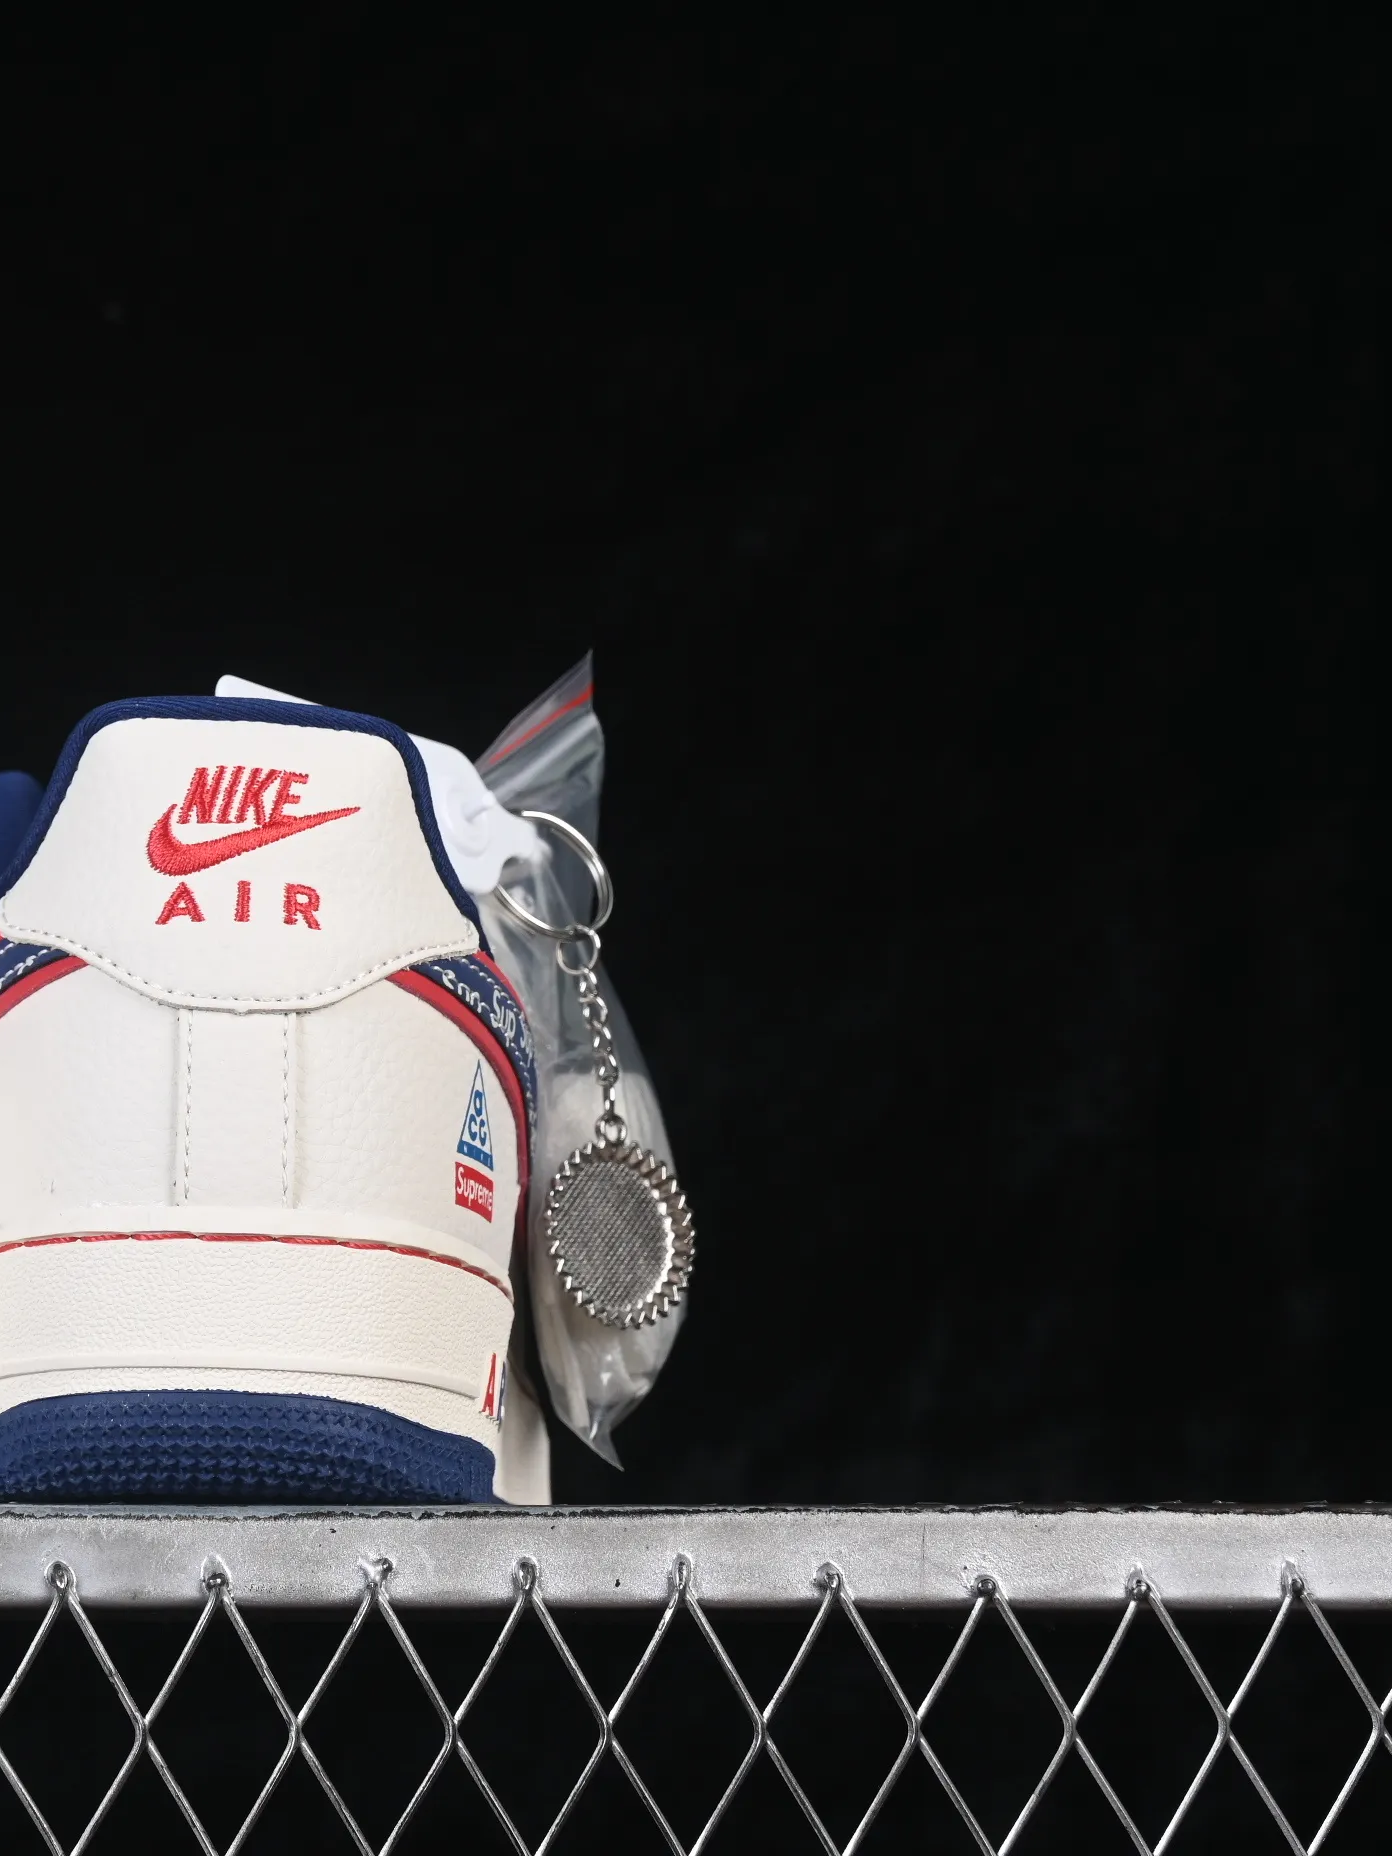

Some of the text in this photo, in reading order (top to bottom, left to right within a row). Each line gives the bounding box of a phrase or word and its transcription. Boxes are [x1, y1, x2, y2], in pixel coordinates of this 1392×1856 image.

[177, 765, 309, 826] NIKE
[155, 880, 321, 930] AIR
[457, 1166, 493, 1211] Supreme
